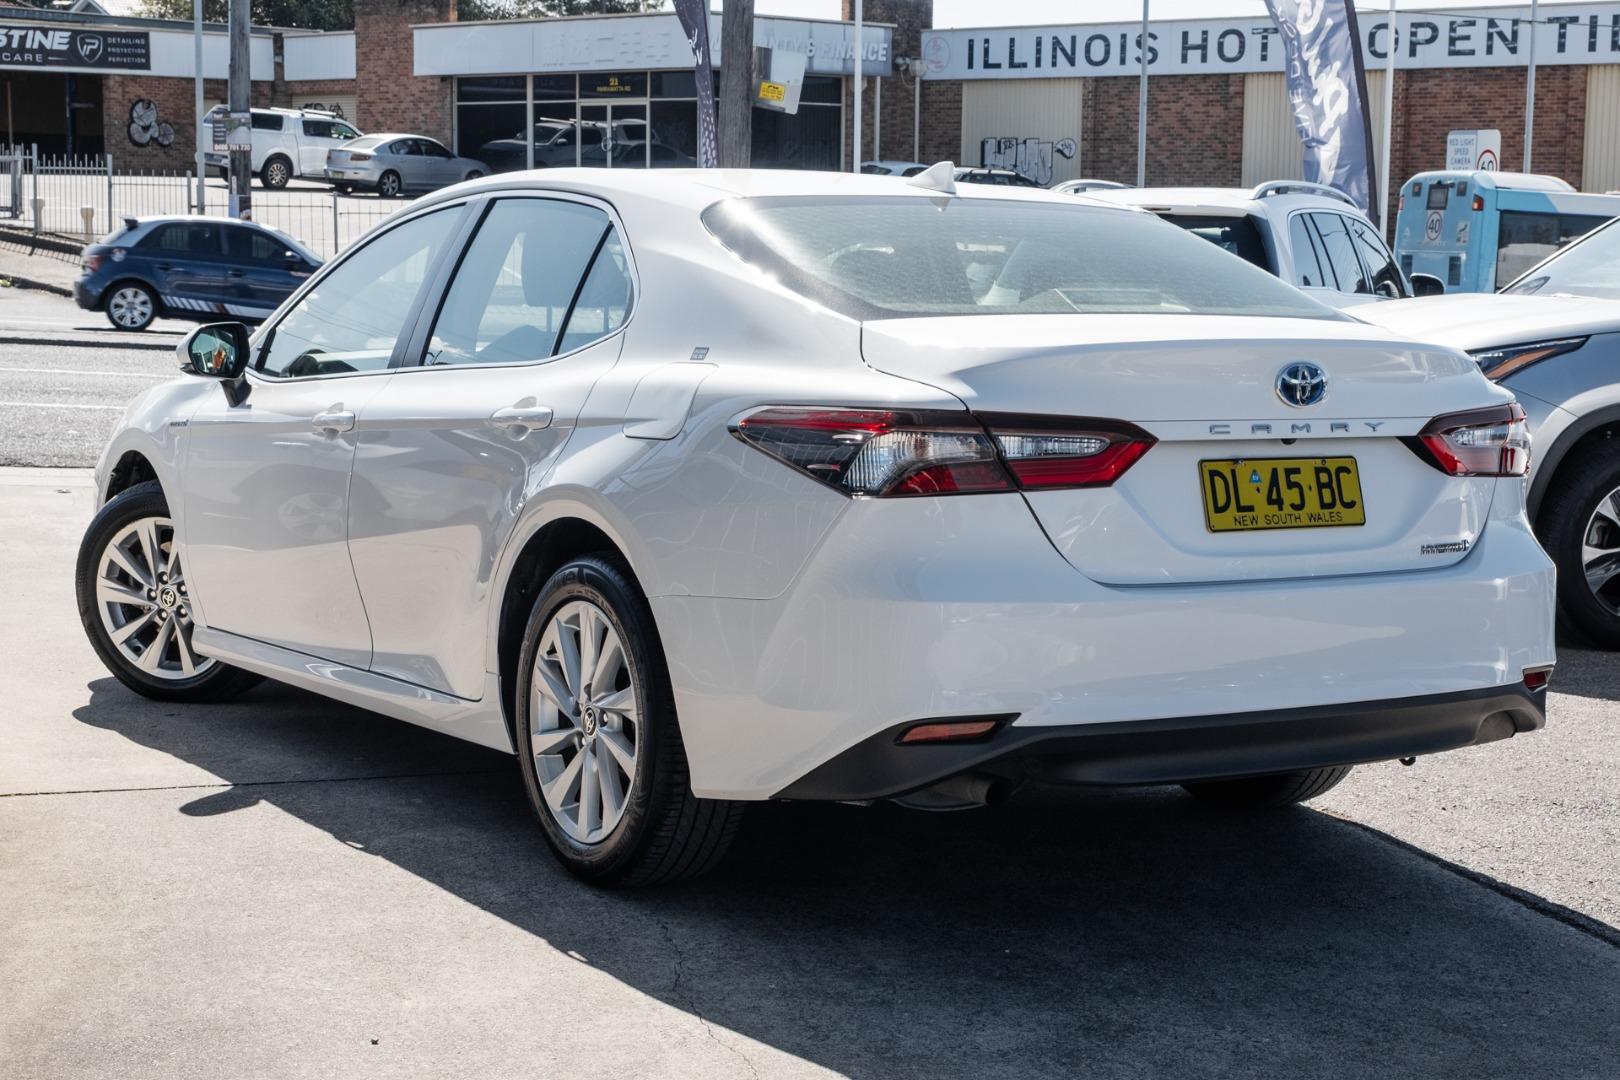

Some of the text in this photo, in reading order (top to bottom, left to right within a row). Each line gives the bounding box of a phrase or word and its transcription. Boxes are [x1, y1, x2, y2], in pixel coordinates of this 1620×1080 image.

[107, 37, 145, 45] DETAILING
[967, 32, 1159, 70] ILLINOIS
[1181, 28, 1280, 64] HOT
[1367, 18, 1520, 59] OPEN
[2, 52, 43, 62] CARE
[1450, 157, 1471, 165] CAMERA
[1428, 218, 1440, 233] 40
[1209, 421, 1385, 435] CAMRY
[1208, 466, 1357, 514] DL 45 BC
[1233, 511, 1343, 527] NEW SOUTH WALES
